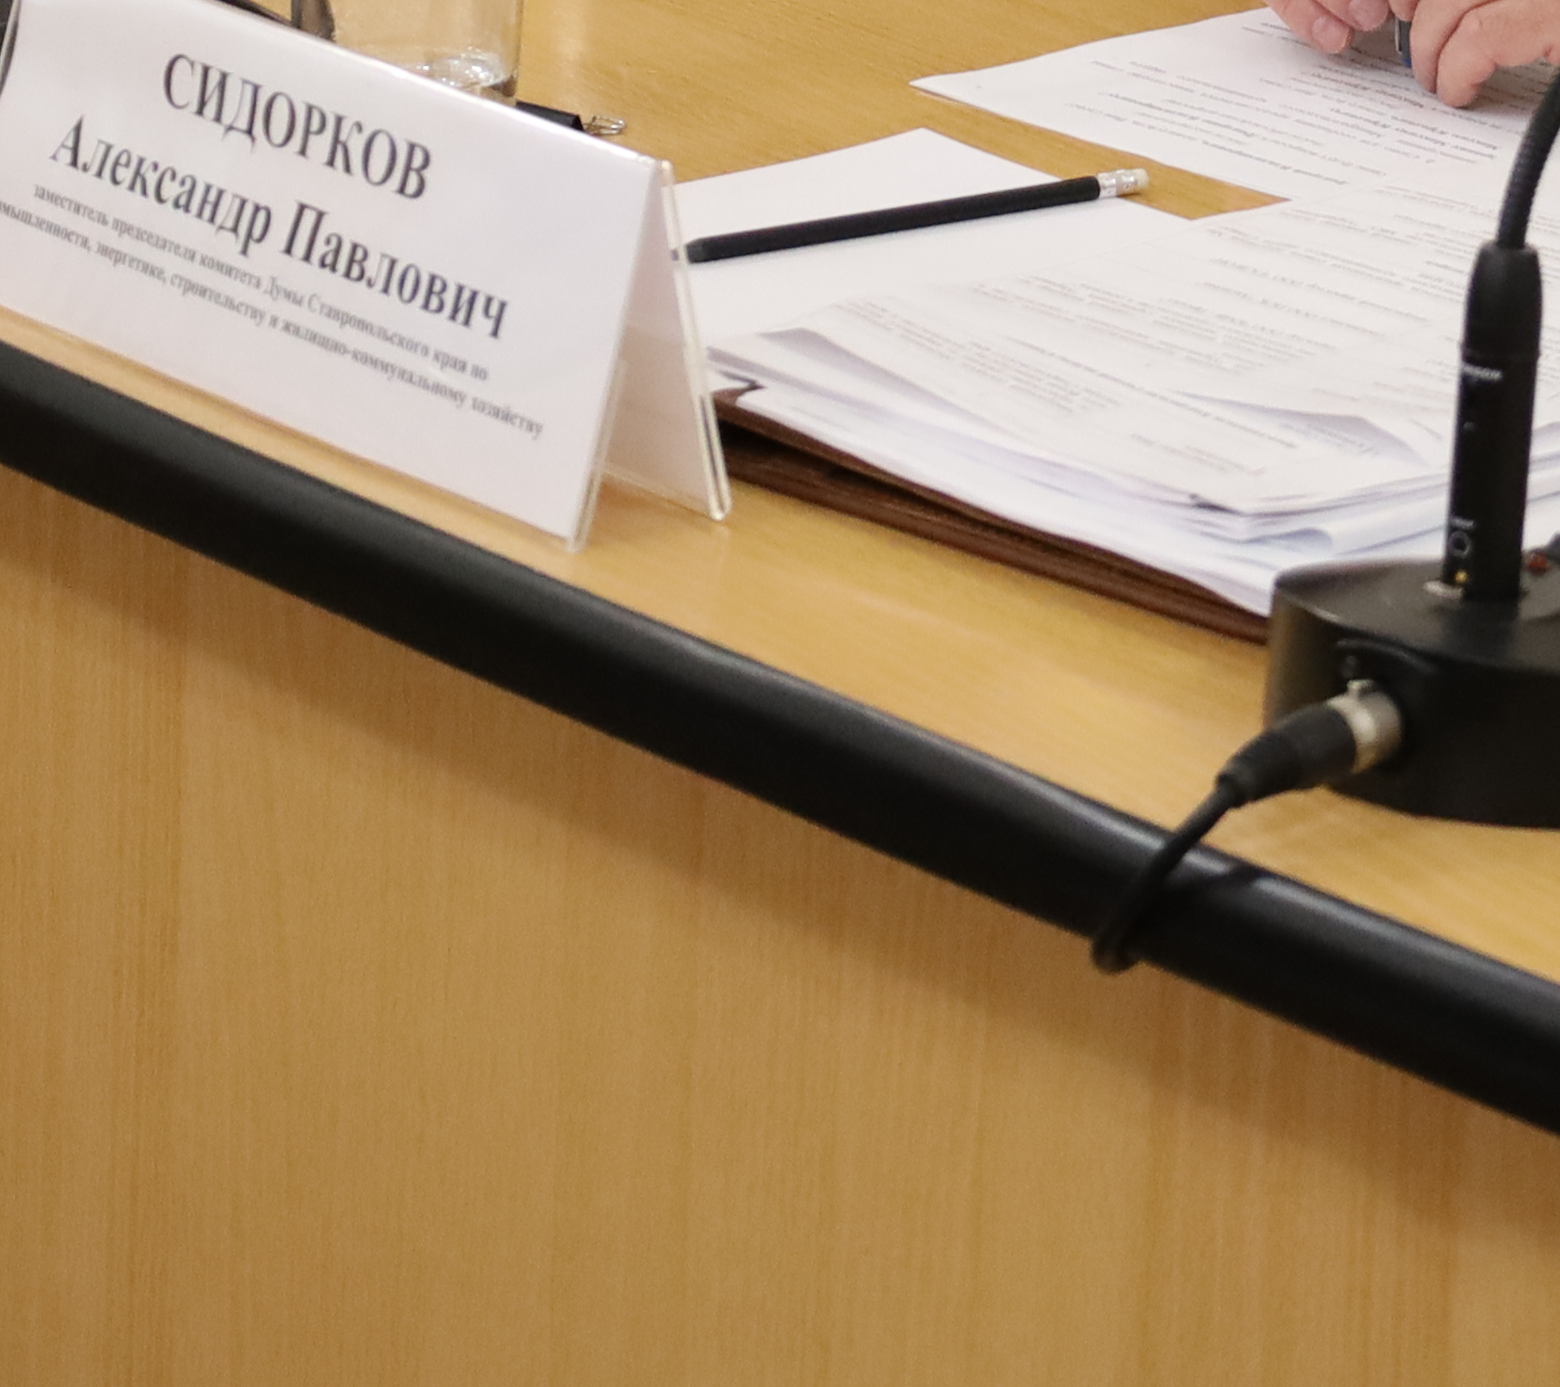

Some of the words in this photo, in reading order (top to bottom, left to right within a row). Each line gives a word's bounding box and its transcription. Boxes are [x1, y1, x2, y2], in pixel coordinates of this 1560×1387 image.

[48, 114, 273, 258] Александр
[280, 199, 510, 340] Павлович
[163, 53, 434, 200] СИДОРКОВ
[34, 183, 109, 228] заместитель
[111, 215, 197, 263] председателя
[198, 253, 262, 290] комитета
[264, 273, 305, 309] Думы
[306, 291, 430, 359] Ставропольского
[432, 348, 469, 376] края
[470, 362, 489, 383] по
[95, 239, 168, 286] энергетике,
[169, 271, 266, 327] строительству
[269, 315, 280, 330] и
[281, 319, 468, 411] жилищно-коммунальному
[470, 396, 544, 441] хозяйству
